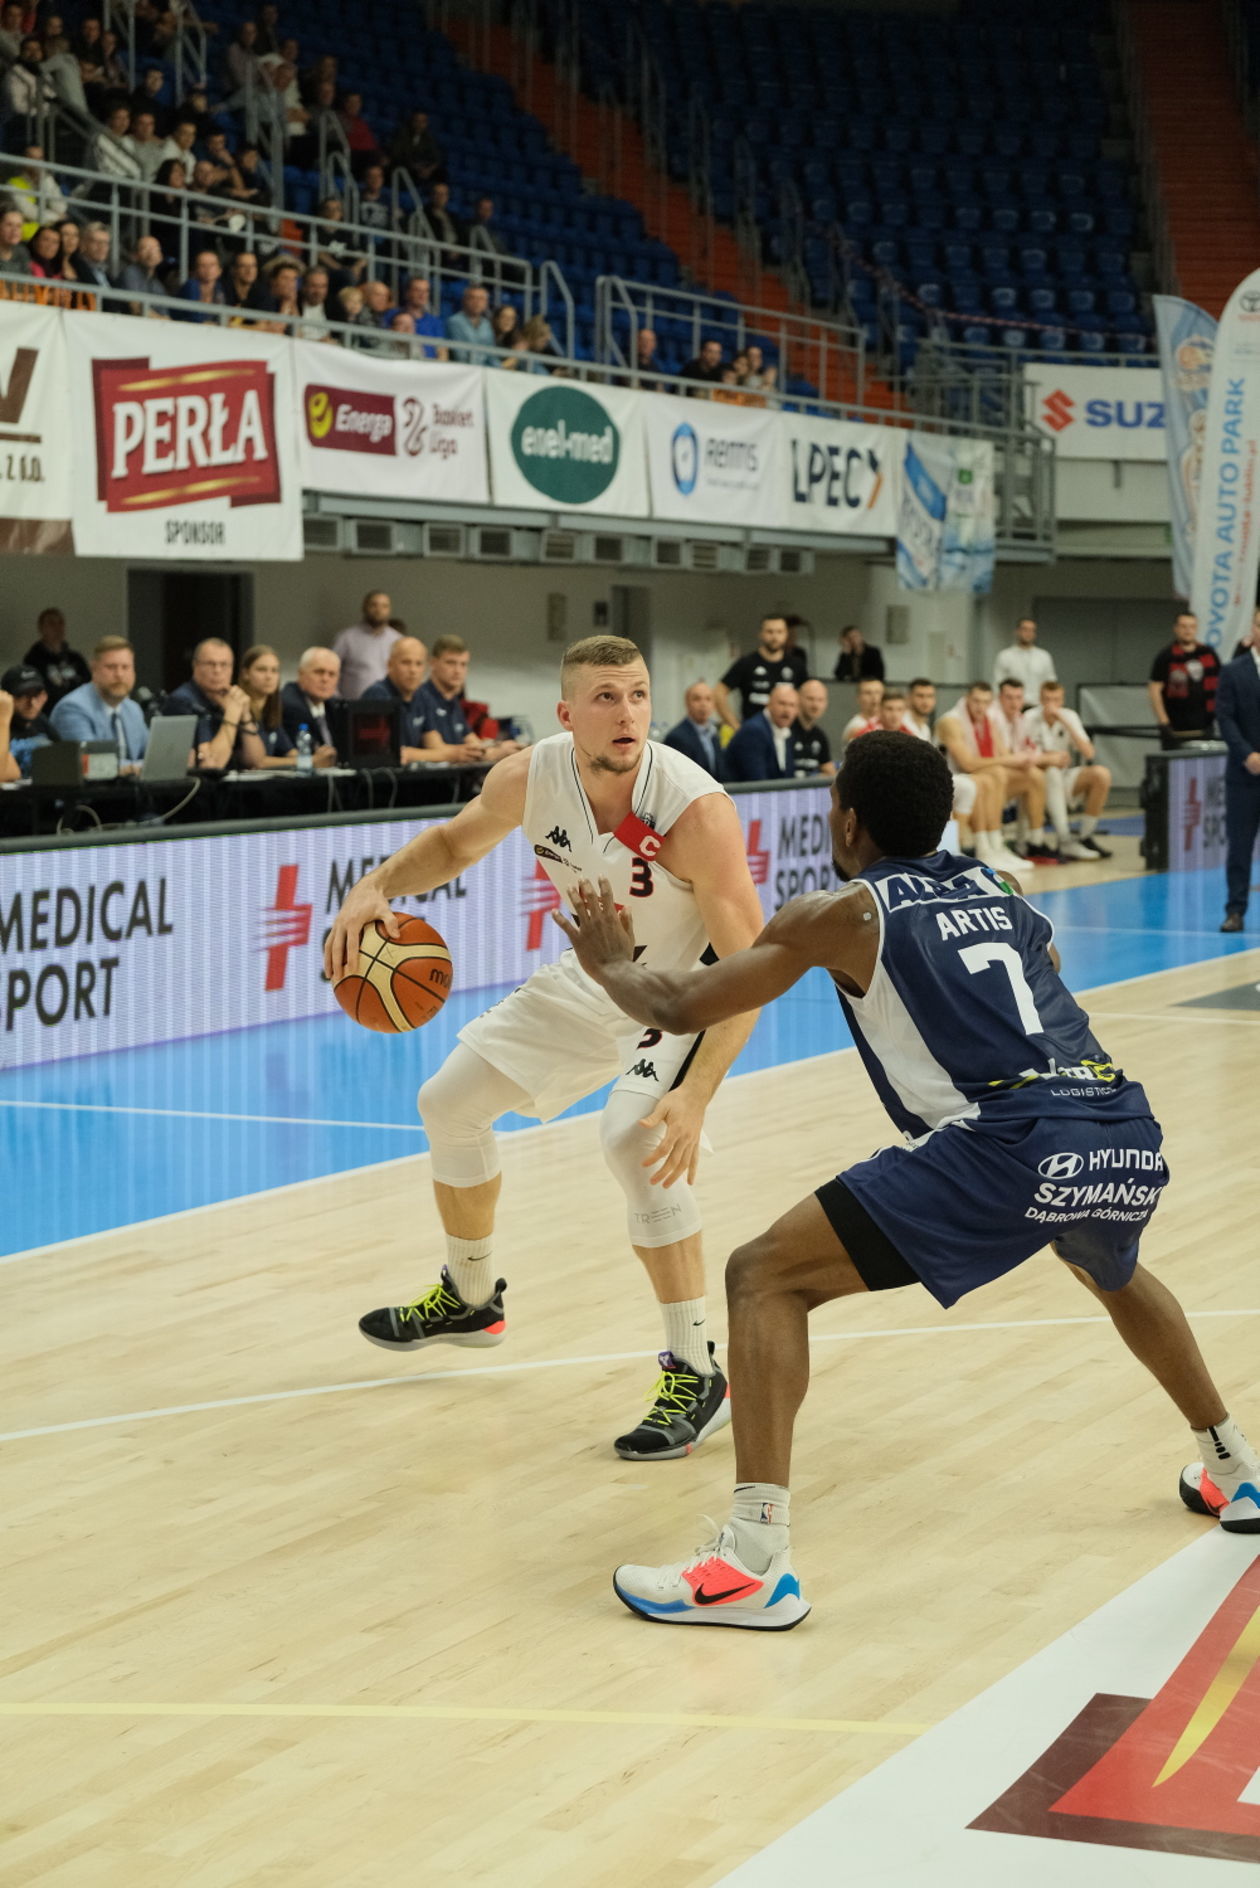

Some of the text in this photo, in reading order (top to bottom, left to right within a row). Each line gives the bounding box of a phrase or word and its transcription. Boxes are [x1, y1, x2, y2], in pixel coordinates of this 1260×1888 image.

[112, 389, 268, 479] PERŁA
[521, 419, 613, 465] enel-med
[1220, 377, 1246, 455] PARK
[791, 440, 862, 508] LPEC
[1215, 461, 1240, 545] AUTO
[165, 520, 225, 545] SPONSOR
[629, 857, 654, 898] 3
[639, 835, 661, 857] C
[0, 877, 174, 954] MEDICAL
[935, 906, 1013, 941] ARTIS
[0, 957, 120, 1032] PORT
[957, 942, 1044, 1036] 7
[1024, 1206, 1089, 1224] DĄBROWA
